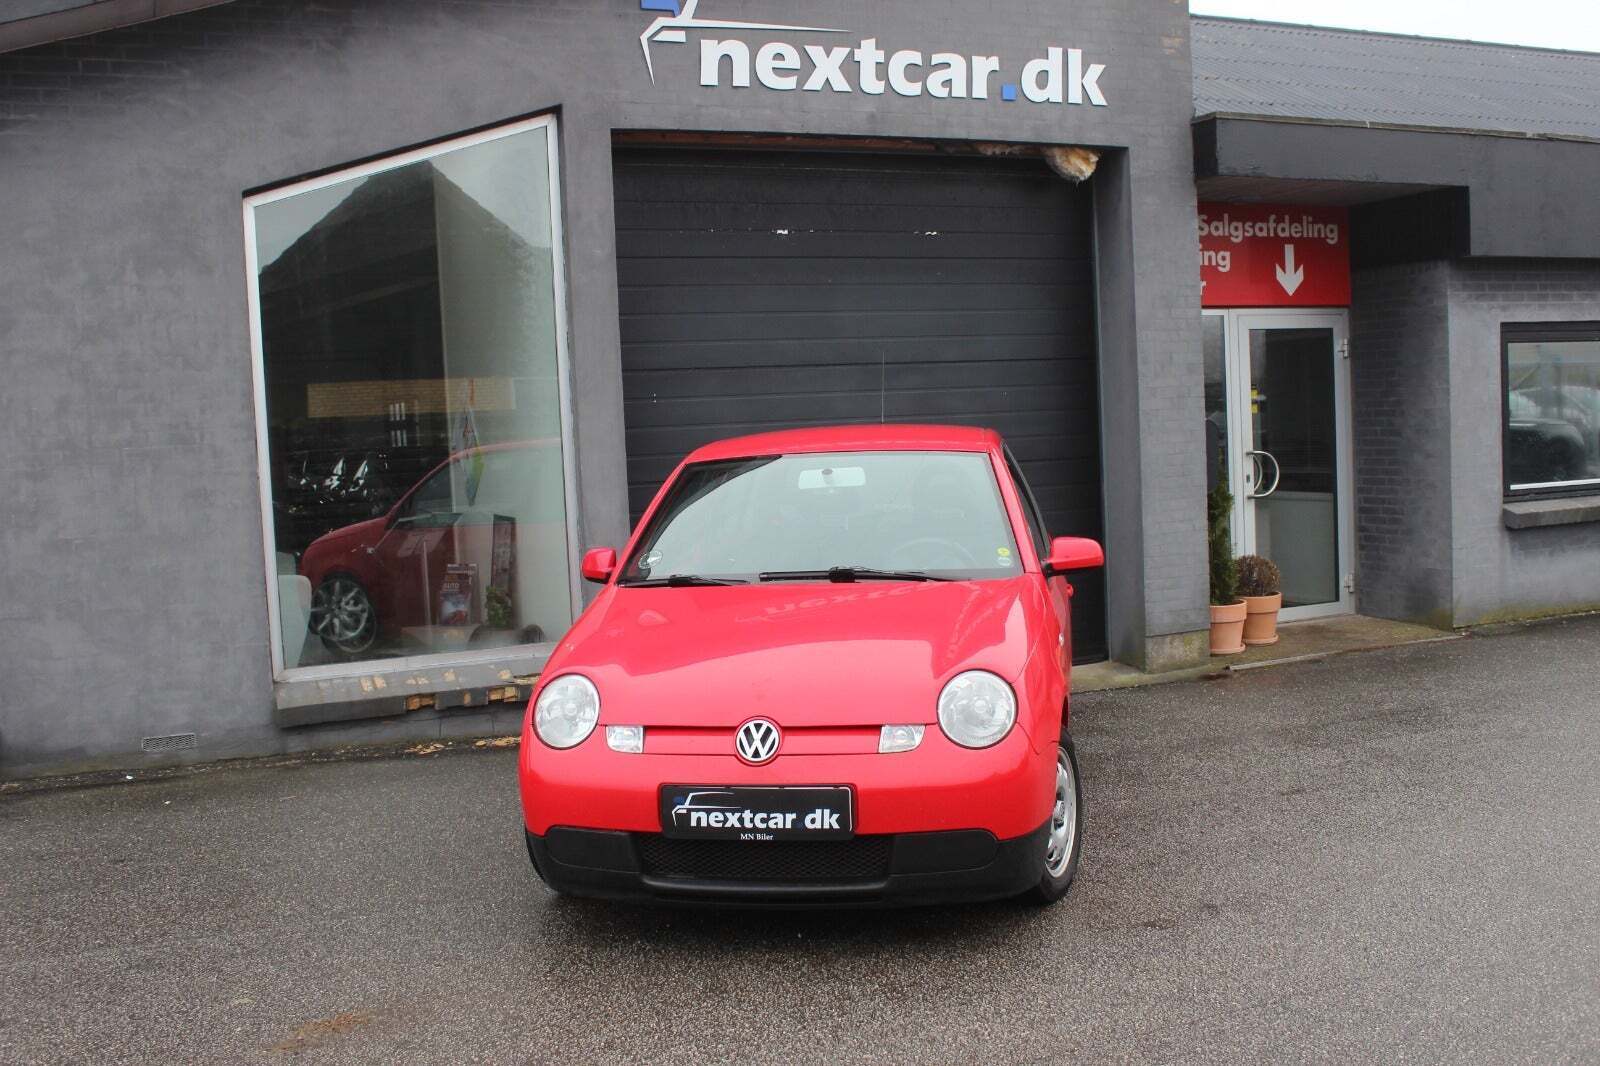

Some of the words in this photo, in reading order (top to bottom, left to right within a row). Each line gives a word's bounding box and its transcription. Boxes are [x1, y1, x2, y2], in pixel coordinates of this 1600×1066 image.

[700, 37, 1108, 106] nextcar.dk
[1198, 213, 1338, 245] Salgsafdeling
[737, 720, 779, 761] VW
[756, 832, 774, 840] Biler
